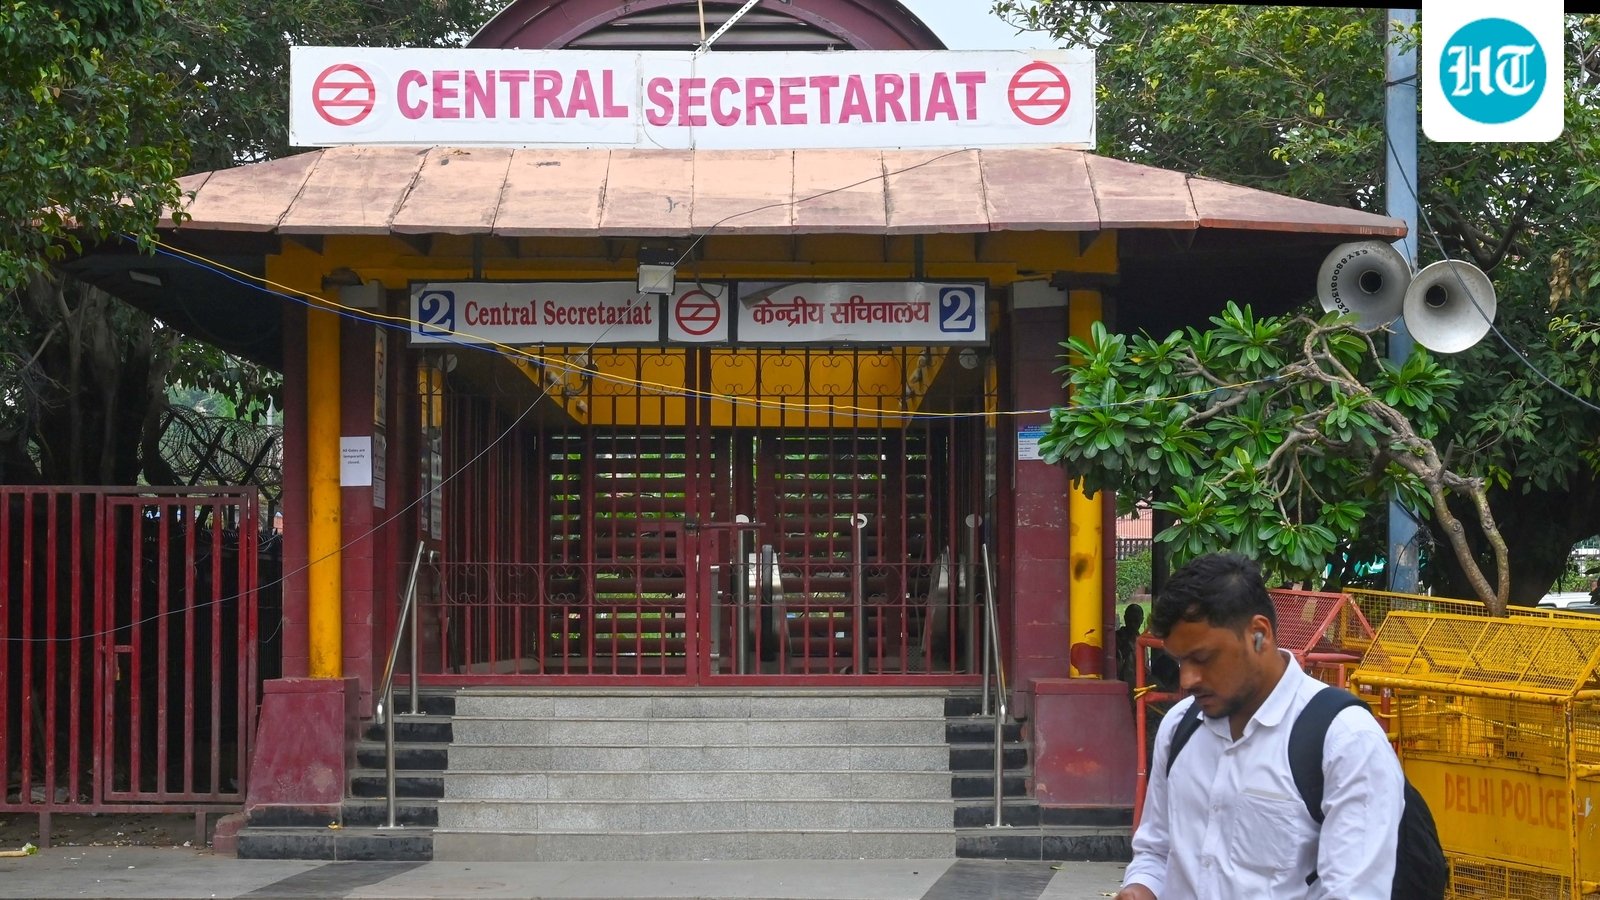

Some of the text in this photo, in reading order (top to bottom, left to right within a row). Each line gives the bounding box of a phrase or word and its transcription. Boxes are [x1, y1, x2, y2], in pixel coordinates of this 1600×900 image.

[396, 69, 986, 127] CENTRAL SECRETARIAT
[421, 293, 652, 333] 2 Central Secretariat
[753, 290, 973, 329] केन्द्रीय सचिवालय 2
[1444, 772, 1567, 832] DELHI POLICE
